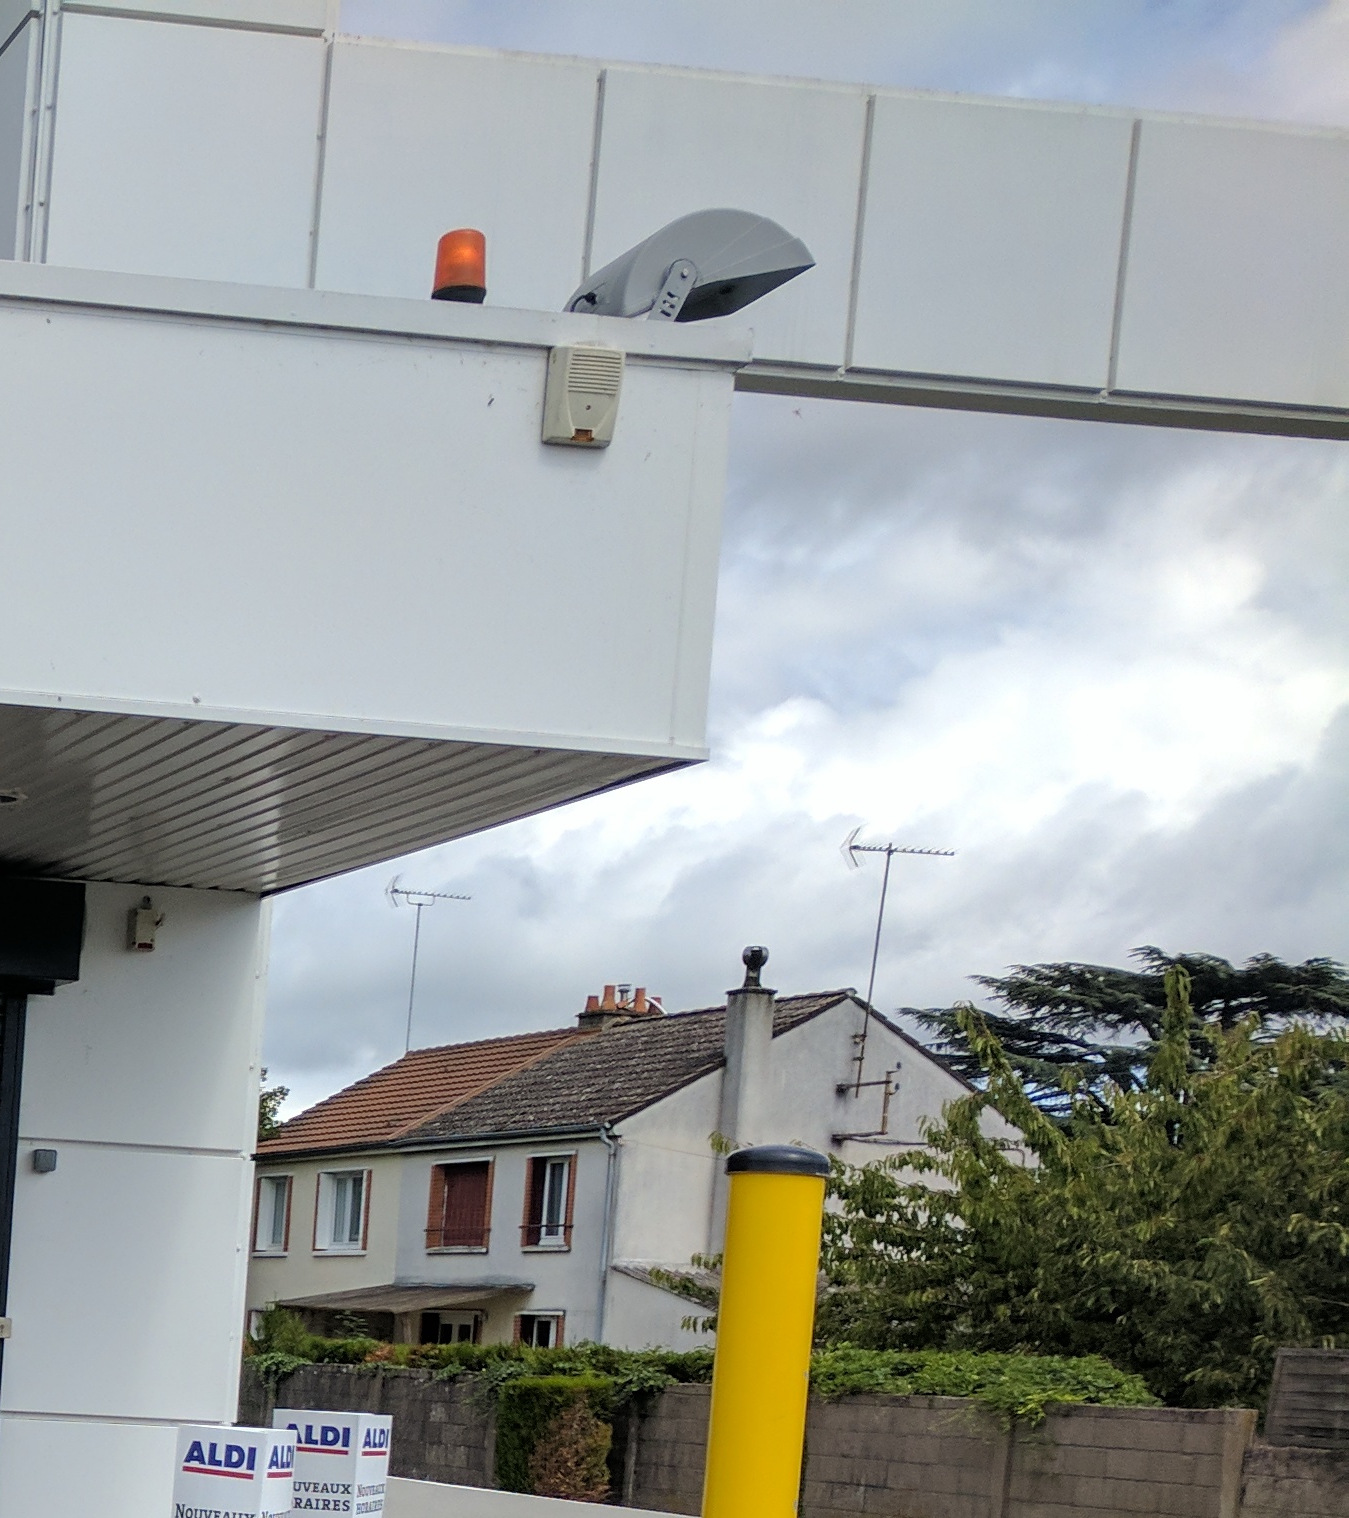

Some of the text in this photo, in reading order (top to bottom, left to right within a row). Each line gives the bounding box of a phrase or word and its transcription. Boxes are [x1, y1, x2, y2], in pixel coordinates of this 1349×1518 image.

[362, 1428, 390, 1448] ALDI
[183, 1440, 257, 1471] ALDI
[293, 1481, 352, 1495] UVEAUX
[293, 1497, 350, 1512] RAIRES
